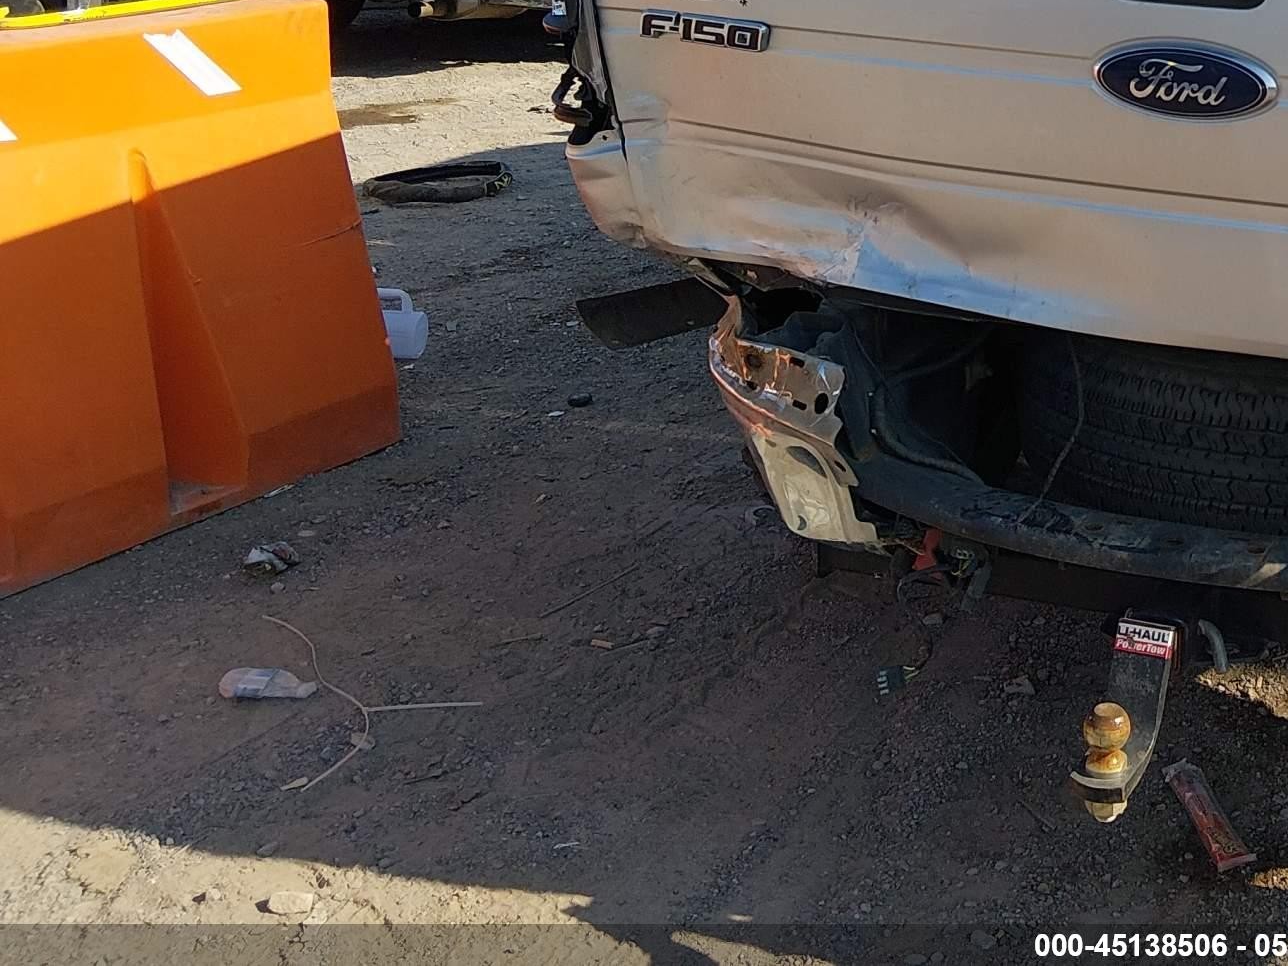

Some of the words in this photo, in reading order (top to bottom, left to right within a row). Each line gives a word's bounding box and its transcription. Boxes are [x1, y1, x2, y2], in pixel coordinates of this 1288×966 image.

[640, 10, 769, 52] F-150
[1129, 58, 1228, 106] Ford
[1116, 638, 1166, 655] PoerTow
[1118, 624, 1170, 643] U-HAUL
